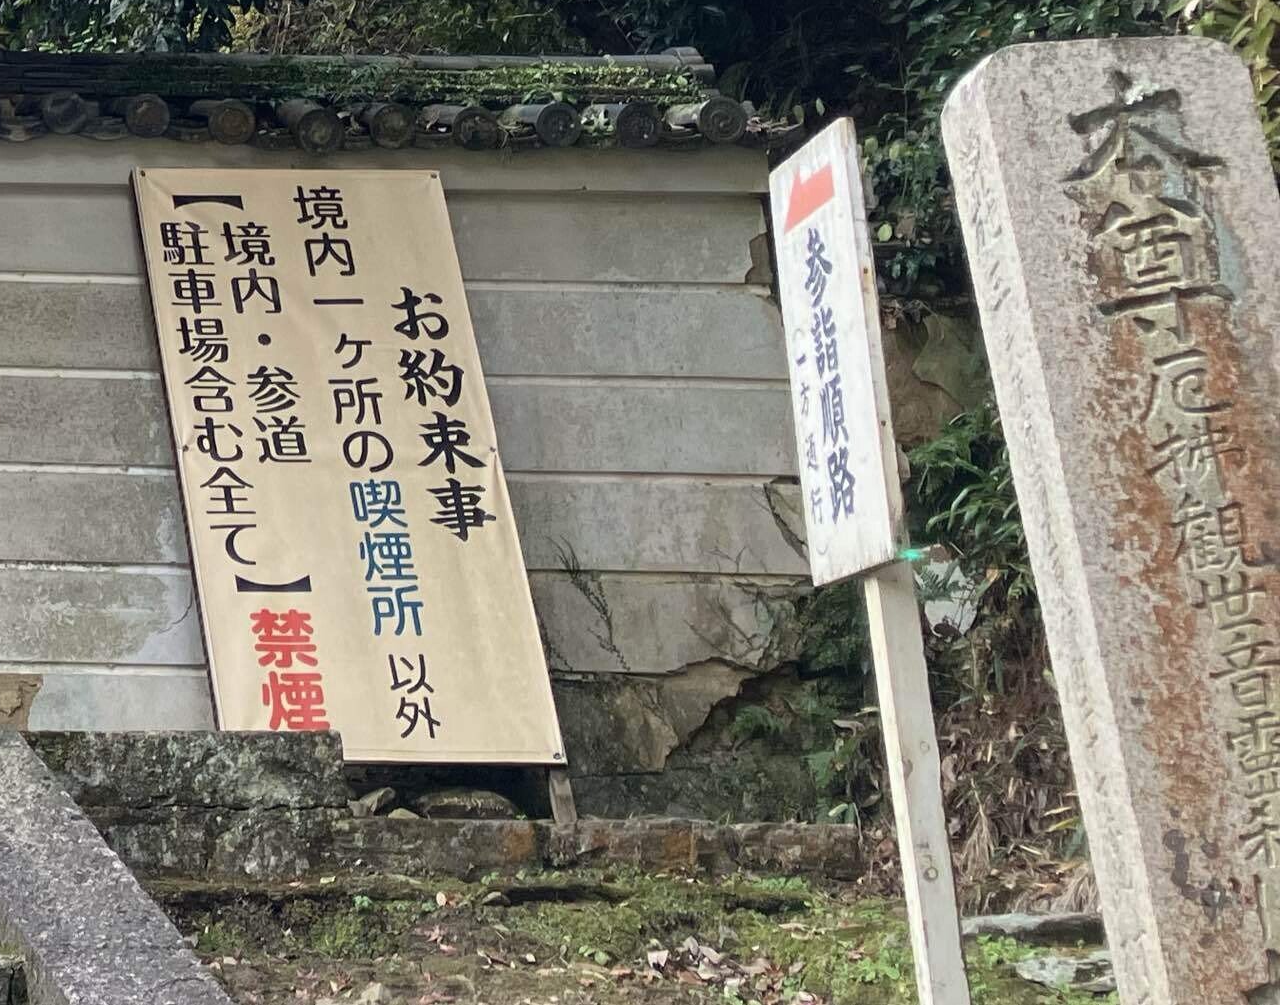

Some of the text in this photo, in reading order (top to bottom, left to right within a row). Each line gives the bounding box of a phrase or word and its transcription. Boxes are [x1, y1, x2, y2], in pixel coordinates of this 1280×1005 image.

[390, 287, 497, 542] お約束事
[804, 227, 855, 524] 参詣順路
[249, 608, 331, 732] 禁煙
